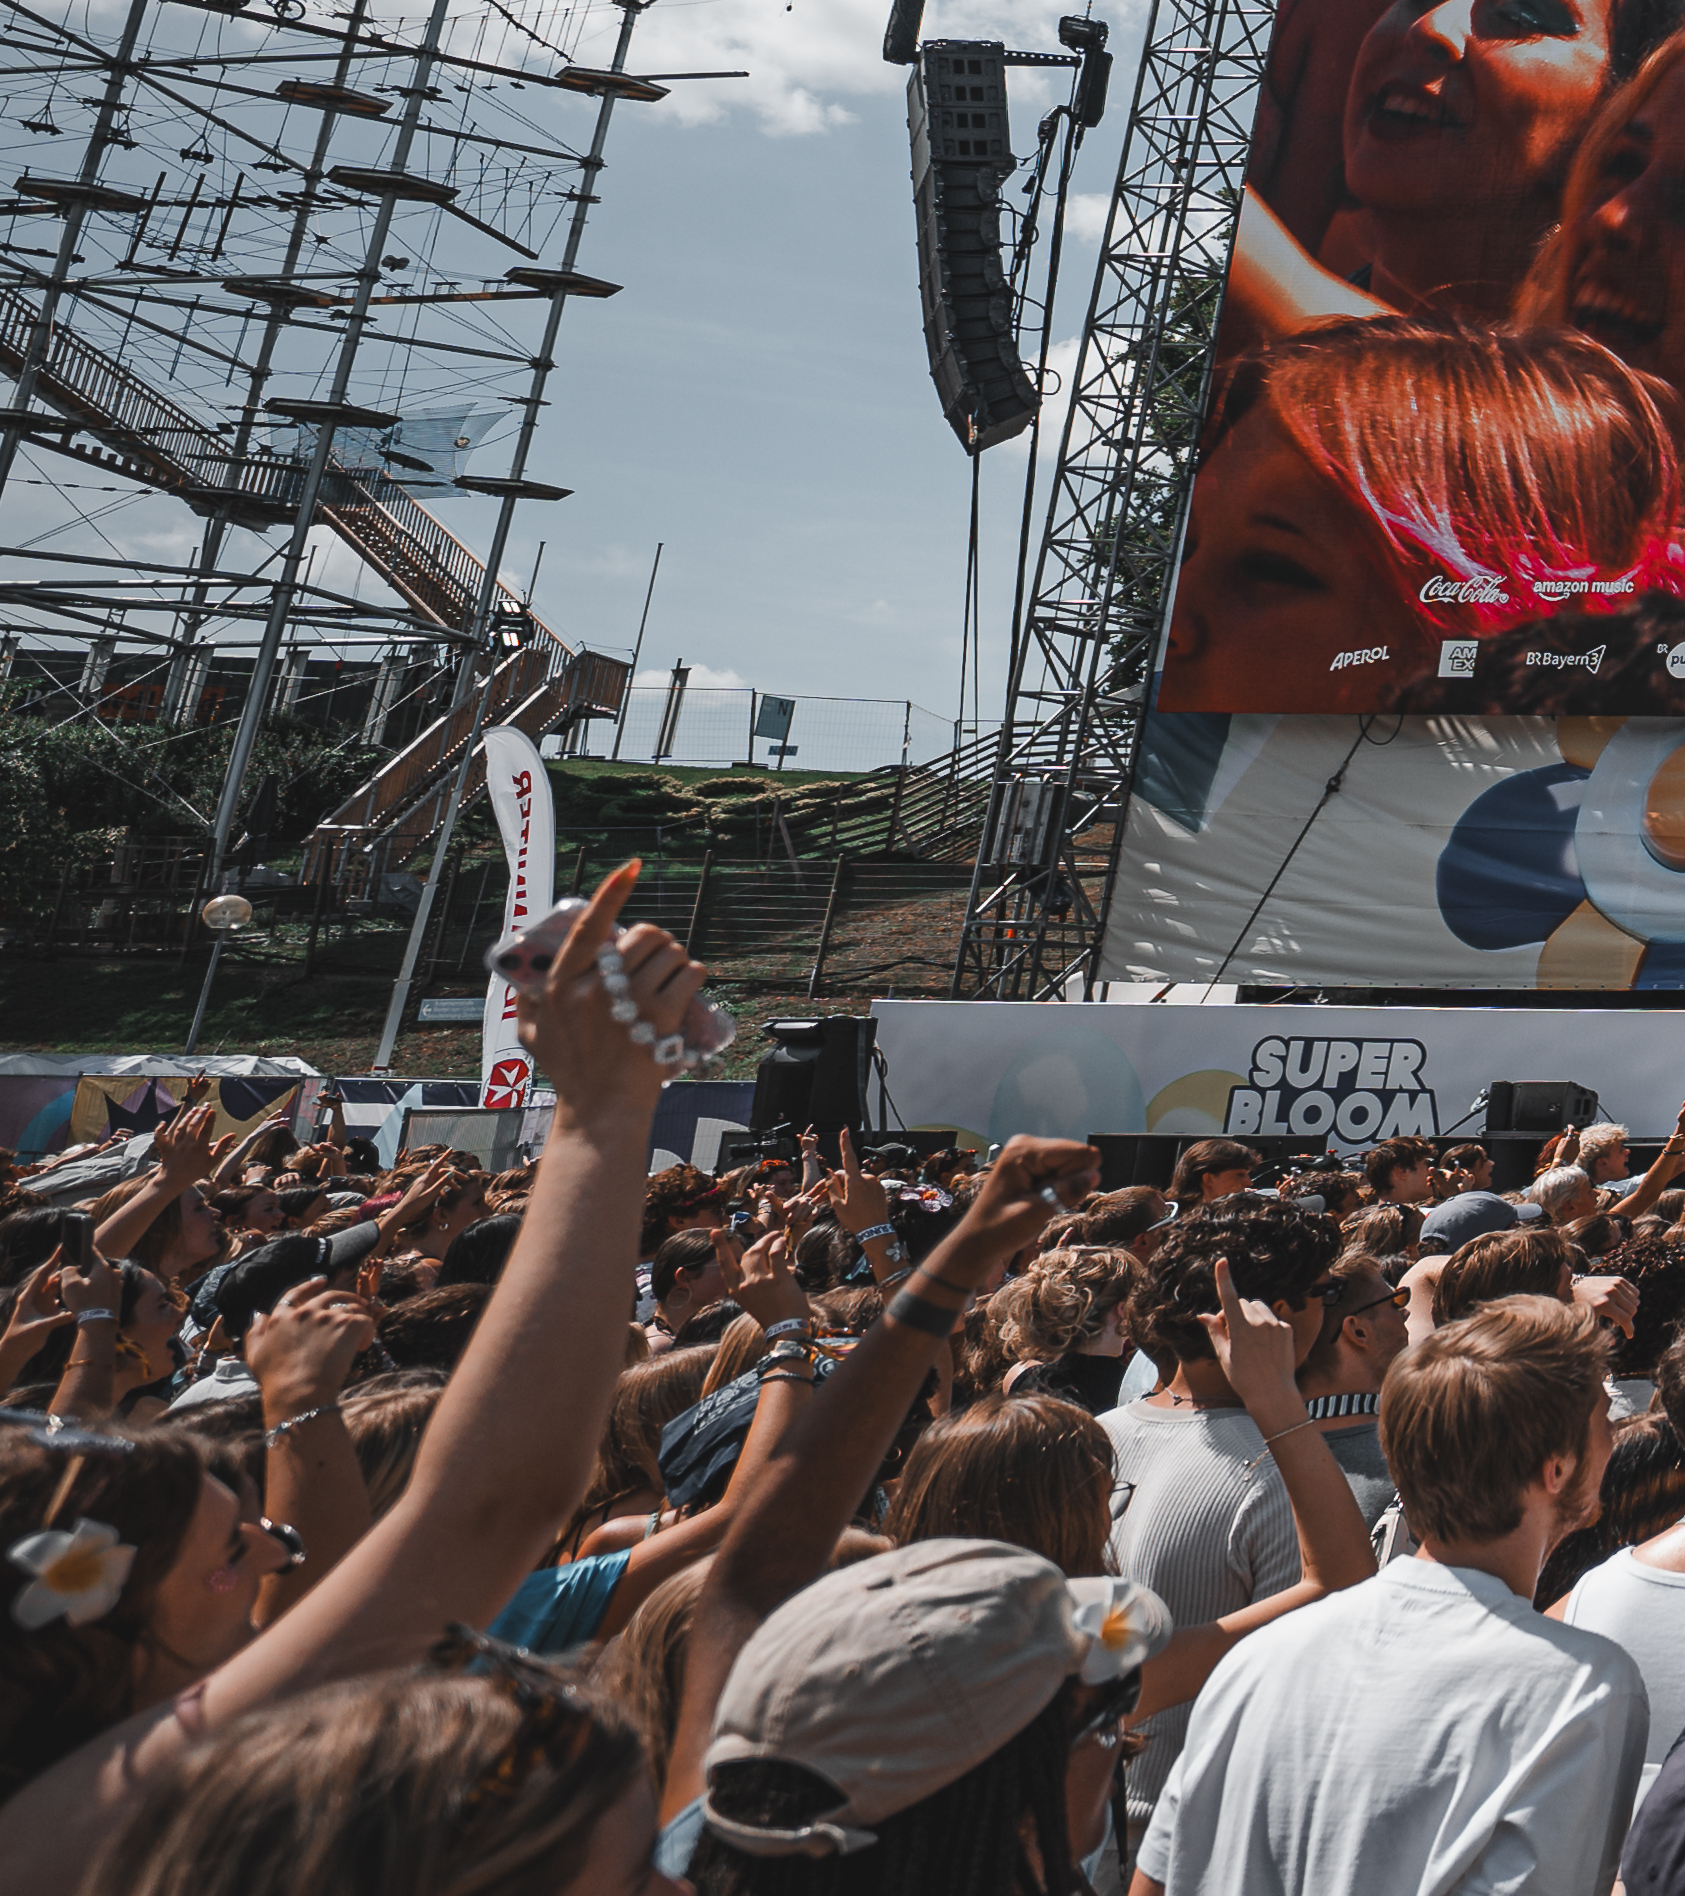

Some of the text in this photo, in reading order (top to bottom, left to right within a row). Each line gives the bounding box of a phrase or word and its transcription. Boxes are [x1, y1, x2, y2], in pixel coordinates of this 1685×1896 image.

[1419, 575, 1506, 604] Coca-Cola
[1532, 579, 1634, 594] amazon music
[1330, 645, 1390, 671] APEROL
[1252, 1037, 1425, 1089] SUPER
[1228, 1087, 1439, 1144] BLOOM
